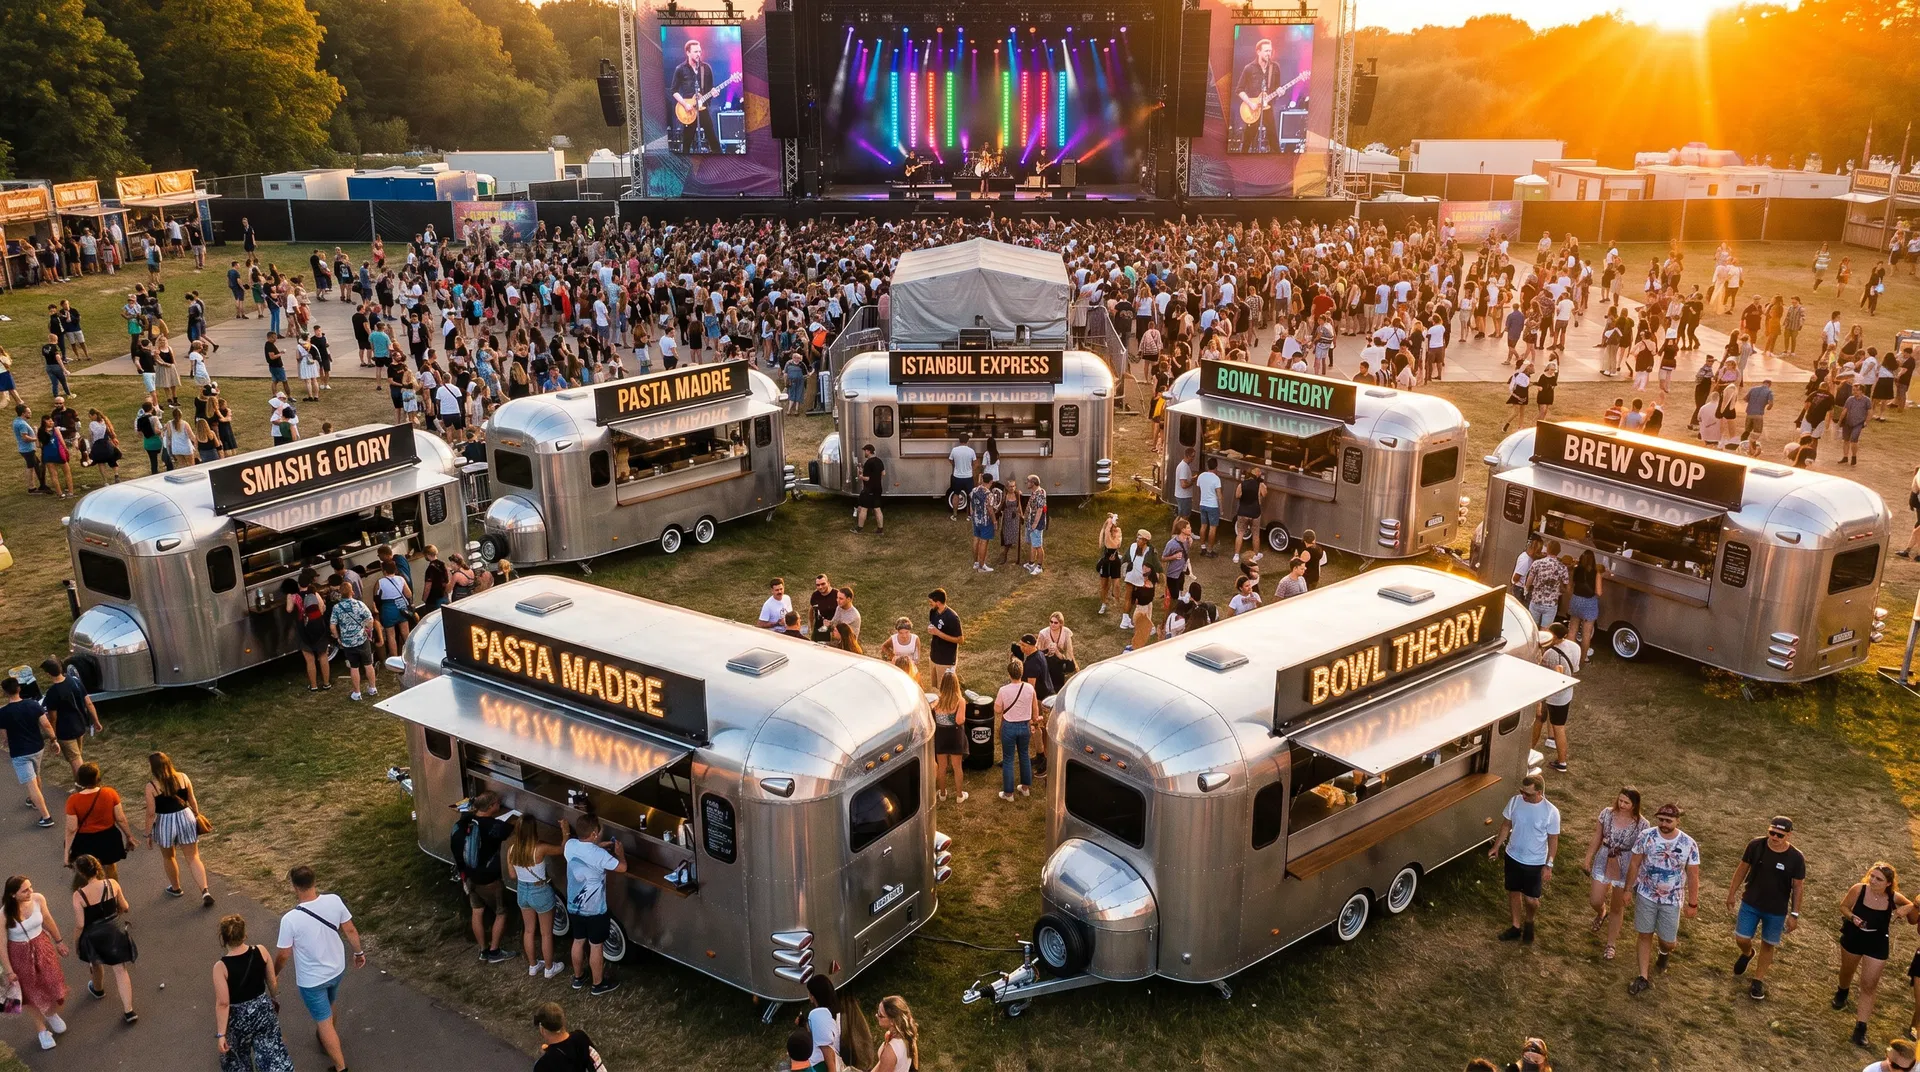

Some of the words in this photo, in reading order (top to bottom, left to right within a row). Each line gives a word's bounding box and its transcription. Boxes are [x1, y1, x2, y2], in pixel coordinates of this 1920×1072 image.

[618, 380, 671, 413] PASTA
[675, 368, 732, 400] MADRE
[902, 356, 976, 375] ISTANBUL
[980, 356, 1049, 375] EXPRESS
[1217, 367, 1262, 397] BOWL
[1268, 376, 1334, 410] THEORY
[241, 454, 313, 496] SMASH
[316, 450, 331, 477] &
[334, 434, 391, 472] GLORY
[1563, 434, 1634, 474] BREW
[1638, 451, 1706, 490] STOP
[470, 625, 555, 684] PASTA
[560, 651, 665, 718] MADRE
[1311, 645, 1386, 705] BOWL
[1390, 605, 1486, 673] THEORY
